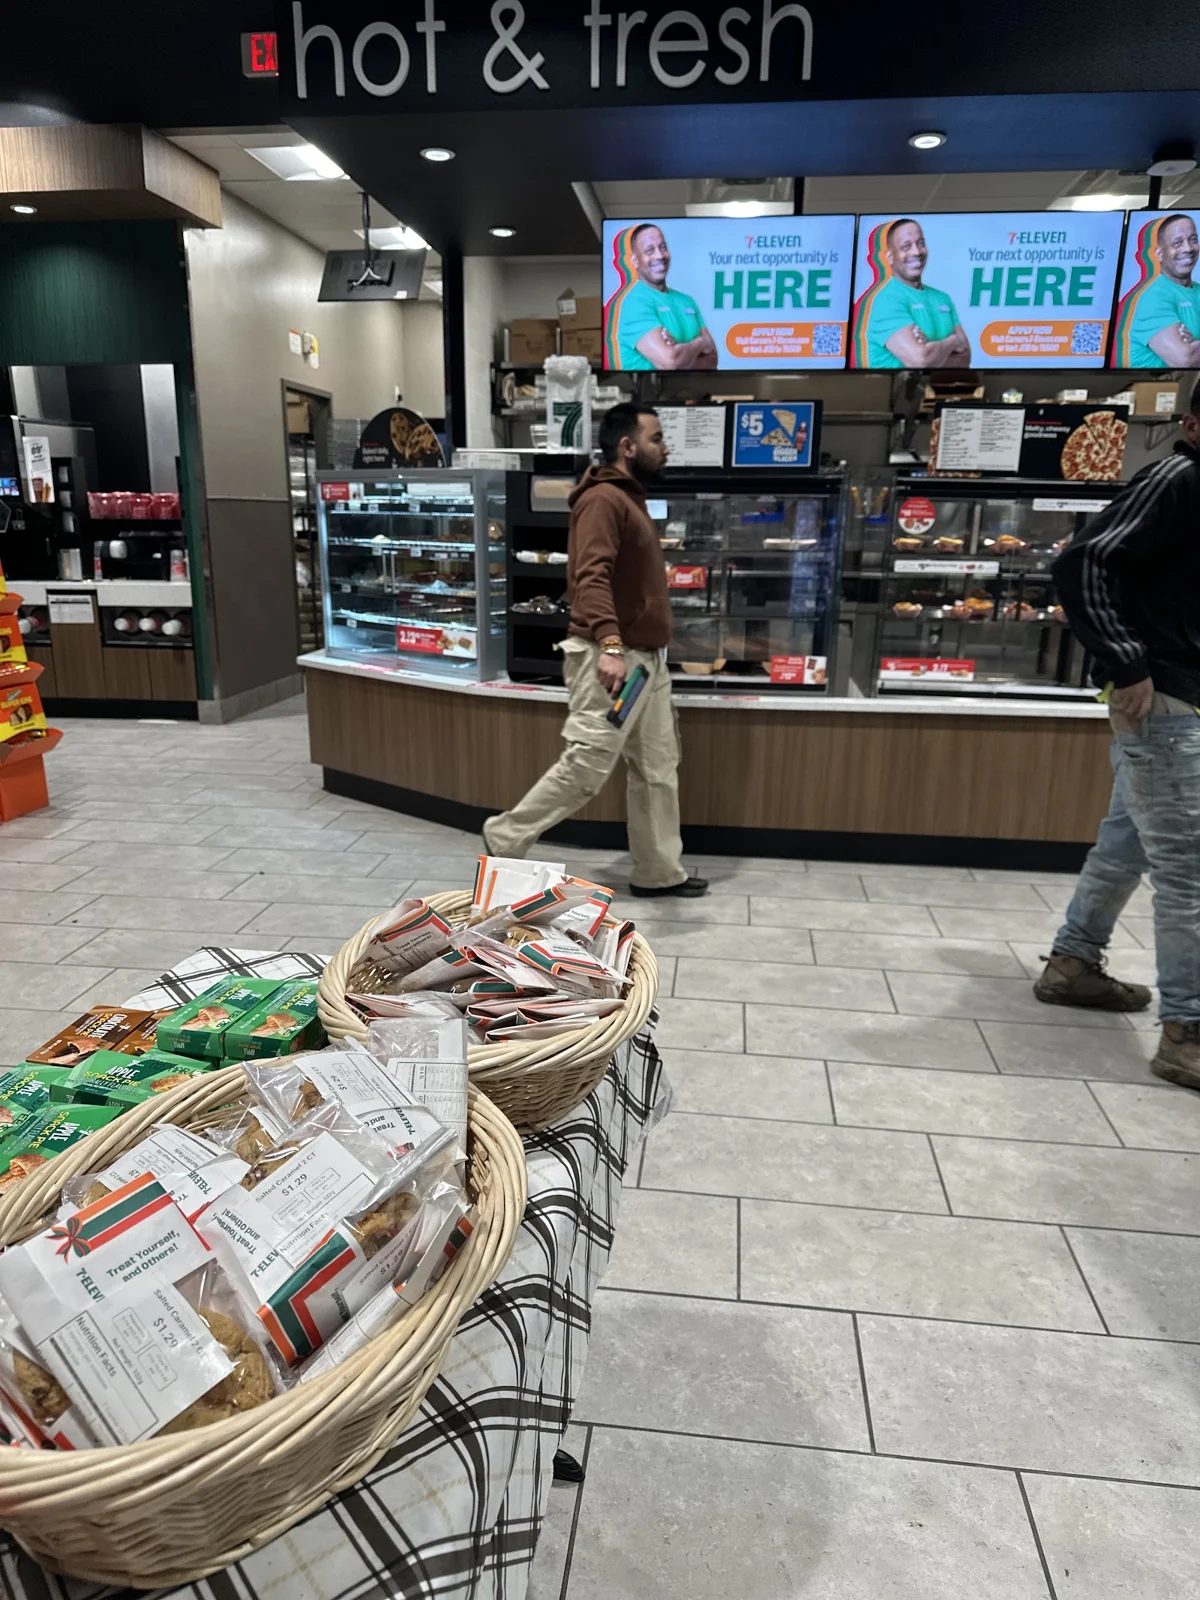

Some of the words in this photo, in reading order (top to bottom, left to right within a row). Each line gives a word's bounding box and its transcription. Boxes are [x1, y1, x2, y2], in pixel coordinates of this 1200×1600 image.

[251, 34, 276, 71] EX
[292, 0, 447, 98] hot
[482, 0, 550, 93] &
[583, 0, 814, 88] fresh
[709, 251, 734, 265] Your
[735, 252, 760, 265] next
[762, 251, 828, 266] opportunity
[830, 250, 839, 263] is
[968, 248, 994, 262] Your
[995, 248, 1022, 261] next
[1024, 247, 1093, 263] opportunity
[1095, 246, 1105, 260] is
[714, 269, 832, 309] HERE
[970, 266, 1097, 306] HERE
[552, 402, 583, 447] 7
[741, 413, 764, 436] $5
[84, 1071, 122, 1082] SNACK
[122, 1078, 141, 1087] PIE
[105, 1065, 140, 1079] APPLE
[331, 1075, 347, 1091] $1.29
[42, 1111, 70, 1136] SNACK
[48, 1121, 80, 1142] APPLE
[368, 1115, 386, 1127] and
[374, 1121, 397, 1134] Treat
[28, 1136, 46, 1149] PIE
[174, 1147, 185, 1157] Facts
[128, 1169, 141, 1179] 1.29
[187, 1169, 213, 1196] 7-ELEVE
[255, 1185, 276, 1203] Salted
[276, 1162, 303, 1186] Caramel
[301, 1157, 308, 1166] 2
[307, 1151, 317, 1161] CT
[282, 1174, 308, 1197] $1.29
[221, 1208, 248, 1235] Others!
[246, 1225, 261, 1242] and
[236, 1235, 258, 1256] Treat
[280, 1226, 308, 1254] Nutrition
[107, 1257, 136, 1278] Treat
[135, 1230, 181, 1260] Yourself,
[122, 1268, 142, 1283] and
[143, 1244, 179, 1271] Others!
[250, 1249, 280, 1279] 7-ELEV
[359, 1263, 379, 1286] Salted
[379, 1237, 405, 1266] Caramel
[380, 1249, 403, 1276] $1.29
[76, 1267, 105, 1303] 7-ELEV
[153, 1289, 174, 1312] Salted
[171, 1310, 197, 1342] Caramel
[191, 1338, 200, 1348] 2
[153, 1317, 179, 1349] $1.29
[76, 1316, 102, 1357] Nutrition
[99, 1354, 118, 1378] Facts
[112, 1338, 120, 1348] Net
[132, 1368, 144, 1386] 102g
